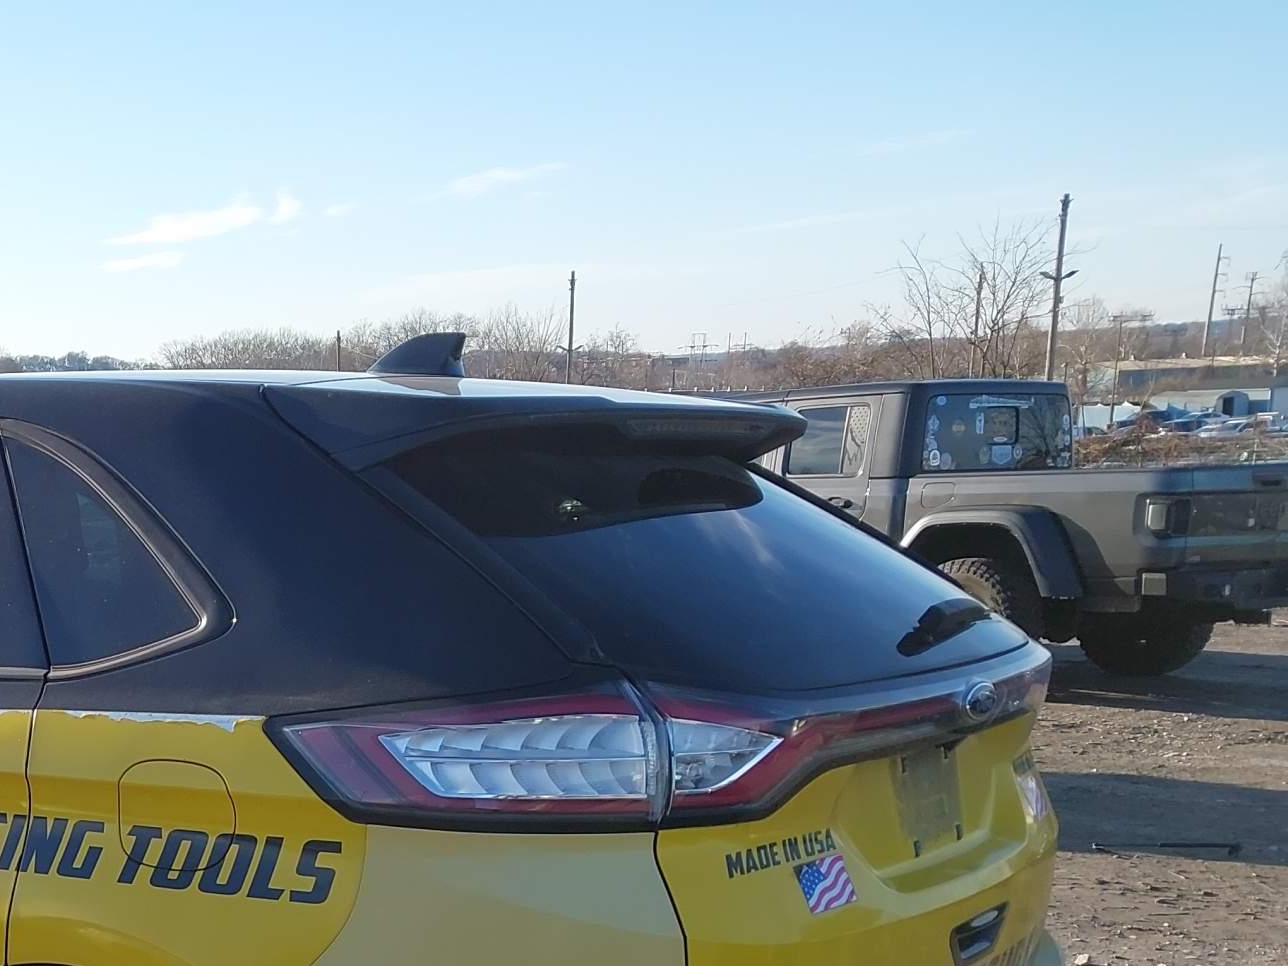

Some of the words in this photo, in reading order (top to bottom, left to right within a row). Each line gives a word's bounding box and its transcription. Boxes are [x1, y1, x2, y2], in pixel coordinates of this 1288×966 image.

[117, 824, 343, 905] TOOLS
[725, 841, 781, 879] MADE
[781, 836, 802, 863] IN
[802, 827, 837, 857] USA
